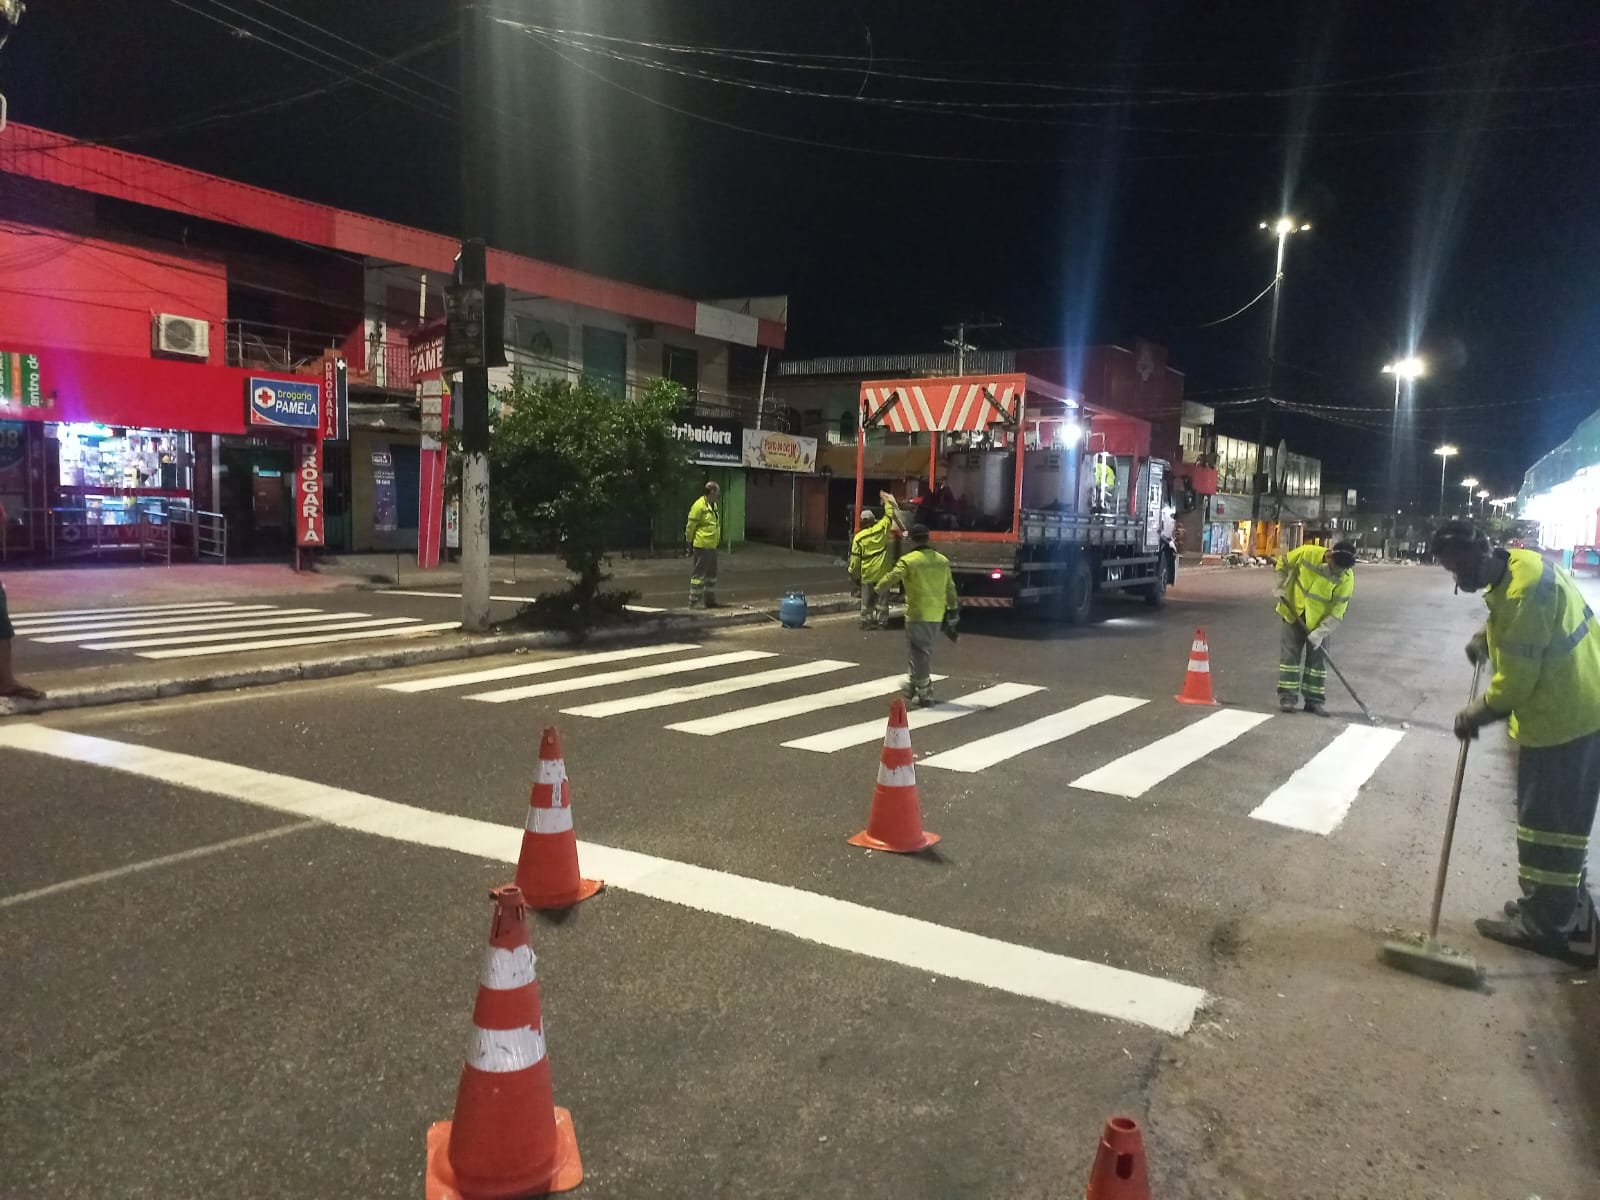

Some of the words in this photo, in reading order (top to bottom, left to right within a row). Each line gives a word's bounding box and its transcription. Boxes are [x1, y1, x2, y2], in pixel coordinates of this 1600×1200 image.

[27, 372, 40, 408] entro
[275, 400, 317, 416] PAMELA
[277, 389, 312, 401] Drogaria
[325, 362, 334, 436] DROGARIA
[301, 444, 320, 542] DROGARIA
